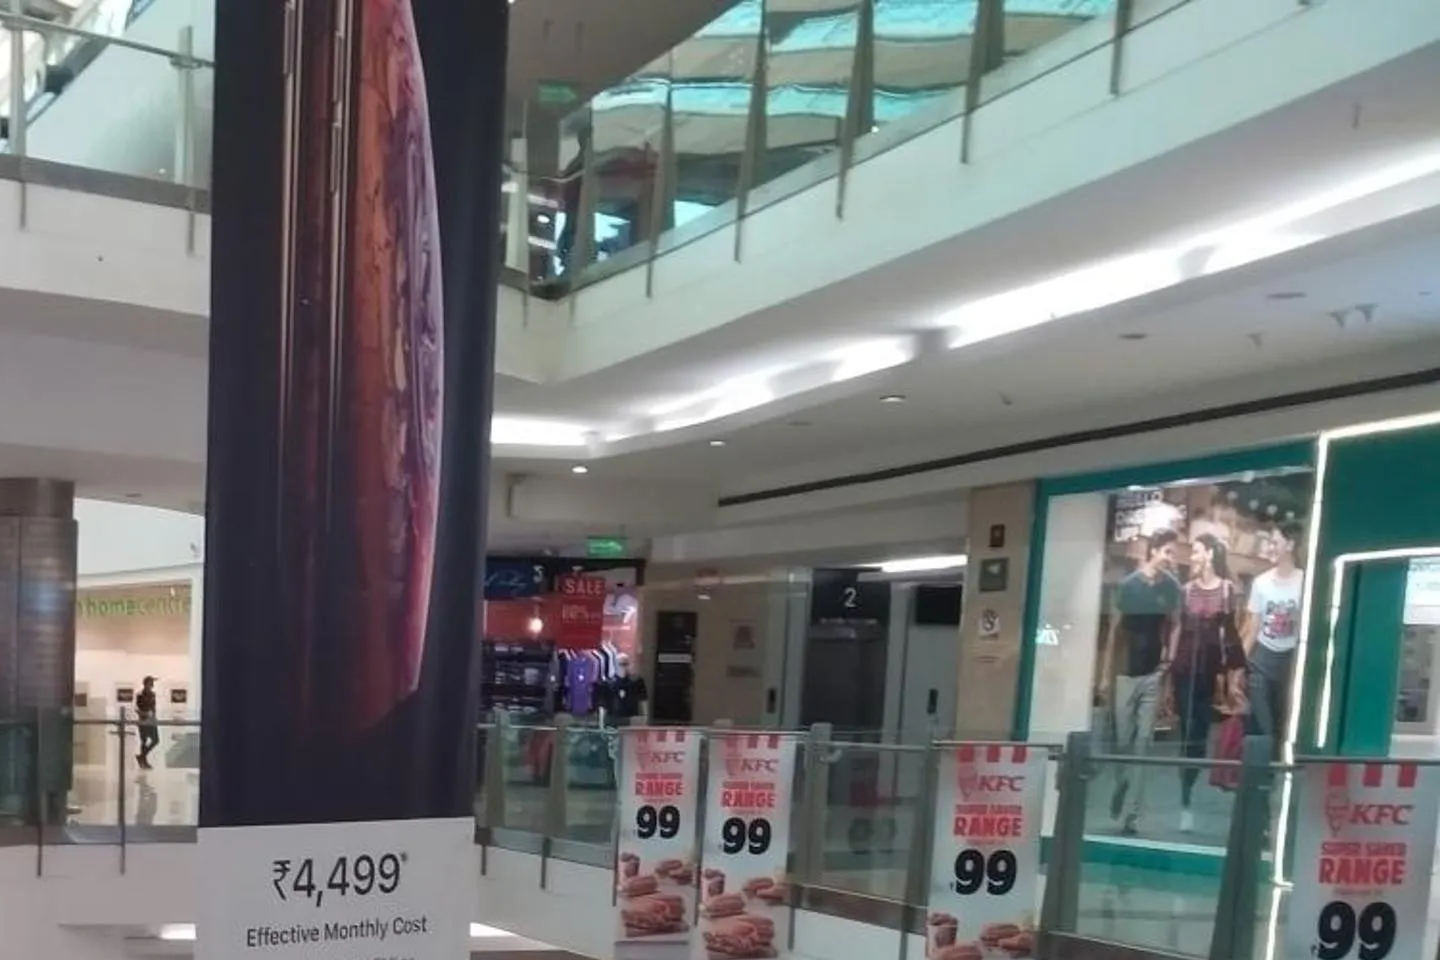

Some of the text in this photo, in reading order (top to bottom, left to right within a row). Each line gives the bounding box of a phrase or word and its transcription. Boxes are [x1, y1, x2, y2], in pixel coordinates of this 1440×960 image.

[844, 588, 857, 608] 2
[635, 780, 684, 796] RANGE
[978, 775, 1026, 792] KFC
[721, 790, 776, 809] RANGE
[636, 805, 681, 840] 99
[1349, 804, 1415, 826] KFC
[953, 817, 1024, 837] RANGE
[1318, 857, 1407, 884] RANGE
[247, 915, 427, 948] Effective Monthly Cost
